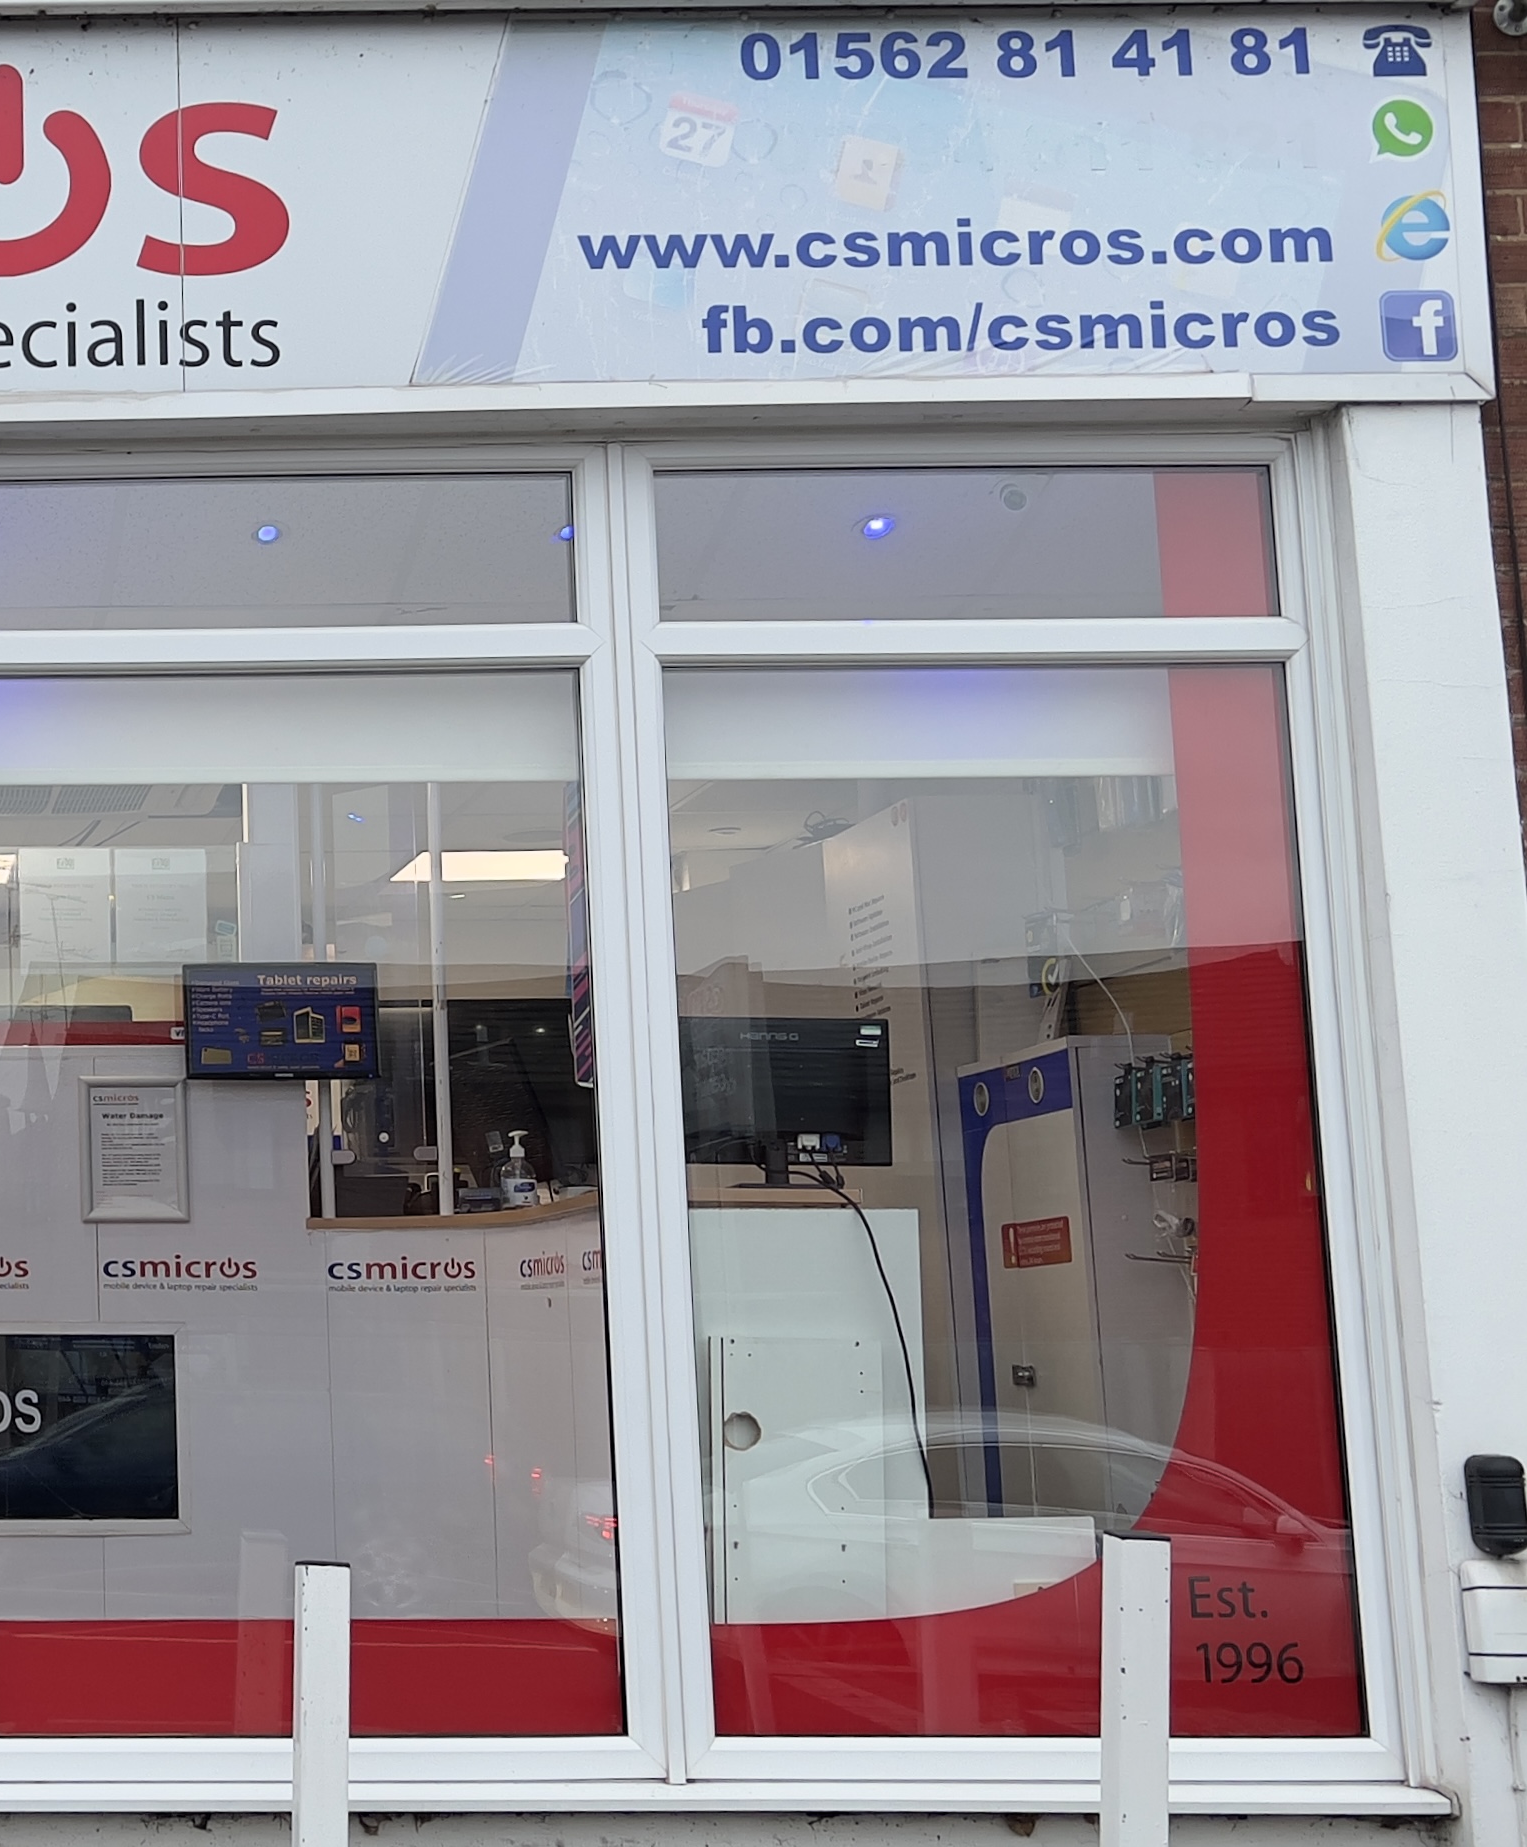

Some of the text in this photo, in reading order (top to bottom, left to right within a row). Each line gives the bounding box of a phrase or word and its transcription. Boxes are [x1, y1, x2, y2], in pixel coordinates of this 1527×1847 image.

[739, 26, 1312, 82] 01562 81 41 81
[577, 218, 1335, 271] www.csmicros.com
[702, 300, 1342, 355] fb.com/csmicros
[257, 973, 357, 987] Tablet repairs
[129, 1113, 164, 1121] Damage
[103, 1254, 257, 1279] csmicros
[327, 1256, 476, 1280] csmicros
[520, 1251, 565, 1278] csmicros
[1189, 1575, 1270, 1620] Est.
[1195, 1640, 1305, 1686] 1996
